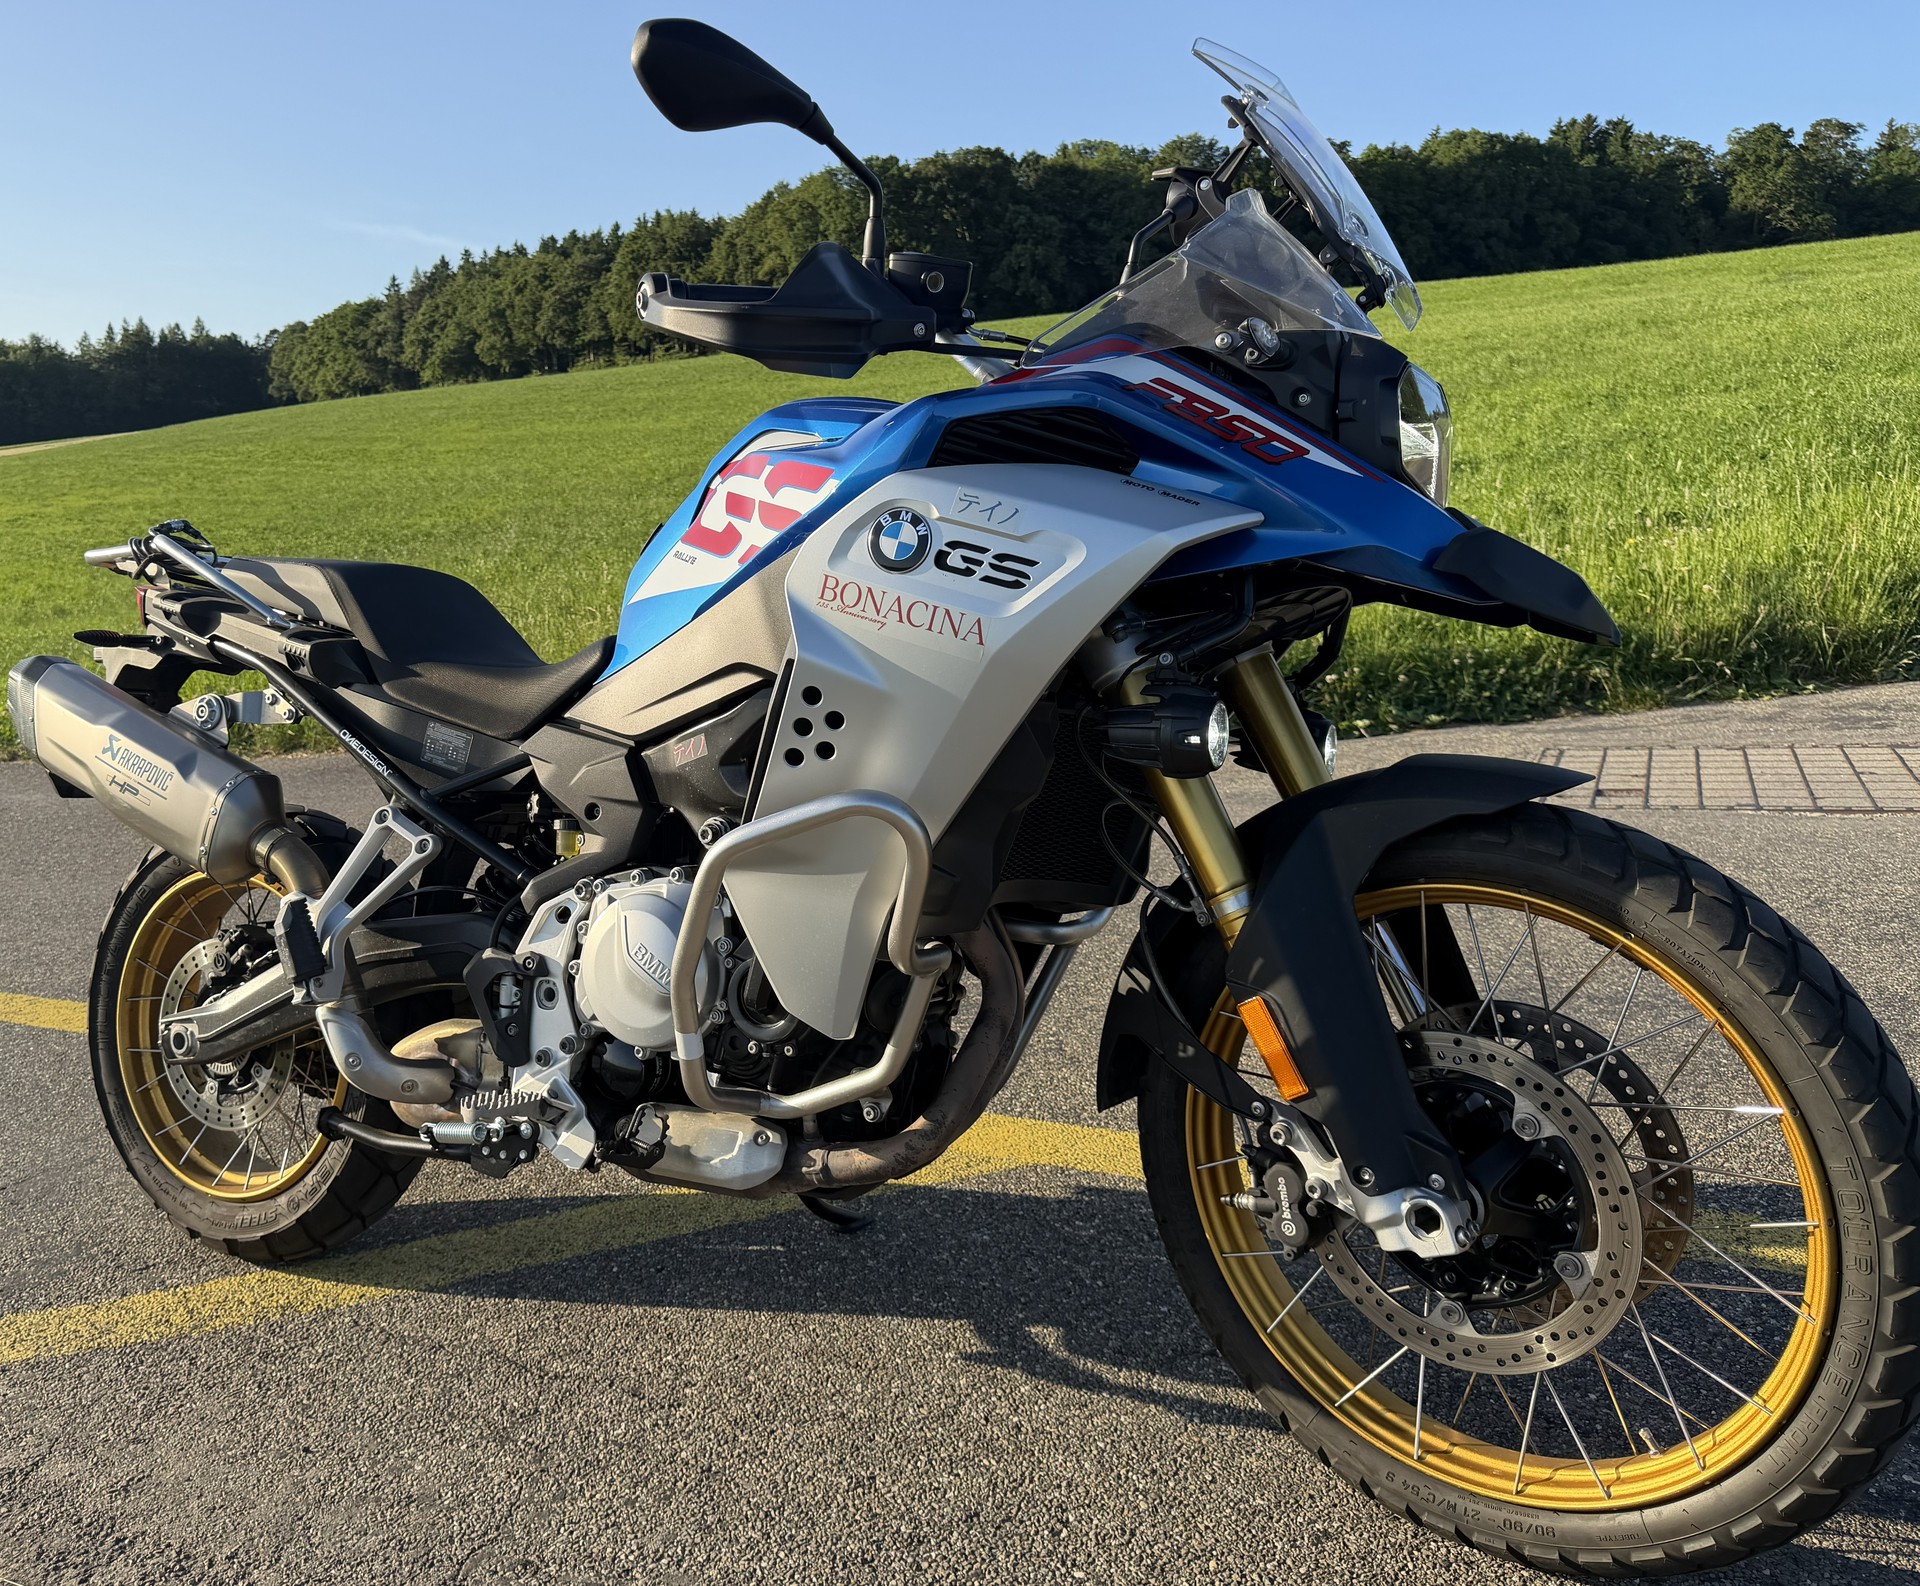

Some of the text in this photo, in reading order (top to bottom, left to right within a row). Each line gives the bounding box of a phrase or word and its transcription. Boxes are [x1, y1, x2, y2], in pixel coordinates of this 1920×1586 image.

[1123, 377, 1310, 465] F850
[1119, 478, 1200, 507] MOTO MADER
[879, 510, 928, 537] BMW
[672, 549, 698, 565] RALLYE
[934, 540, 1042, 590] GS
[816, 601, 887, 631] 135 Anniversary
[818, 574, 985, 646] BONACINA
[340, 729, 393, 776] ONEDESIGN
[109, 775, 140, 796] HP
[631, 943, 671, 986] BMW
[1277, 1177, 1292, 1219] brembo
[1829, 1156, 1873, 1397] TOURANCE
[1770, 1403, 1826, 1475] FRONT
[1463, 1509, 1481, 1522] 21
